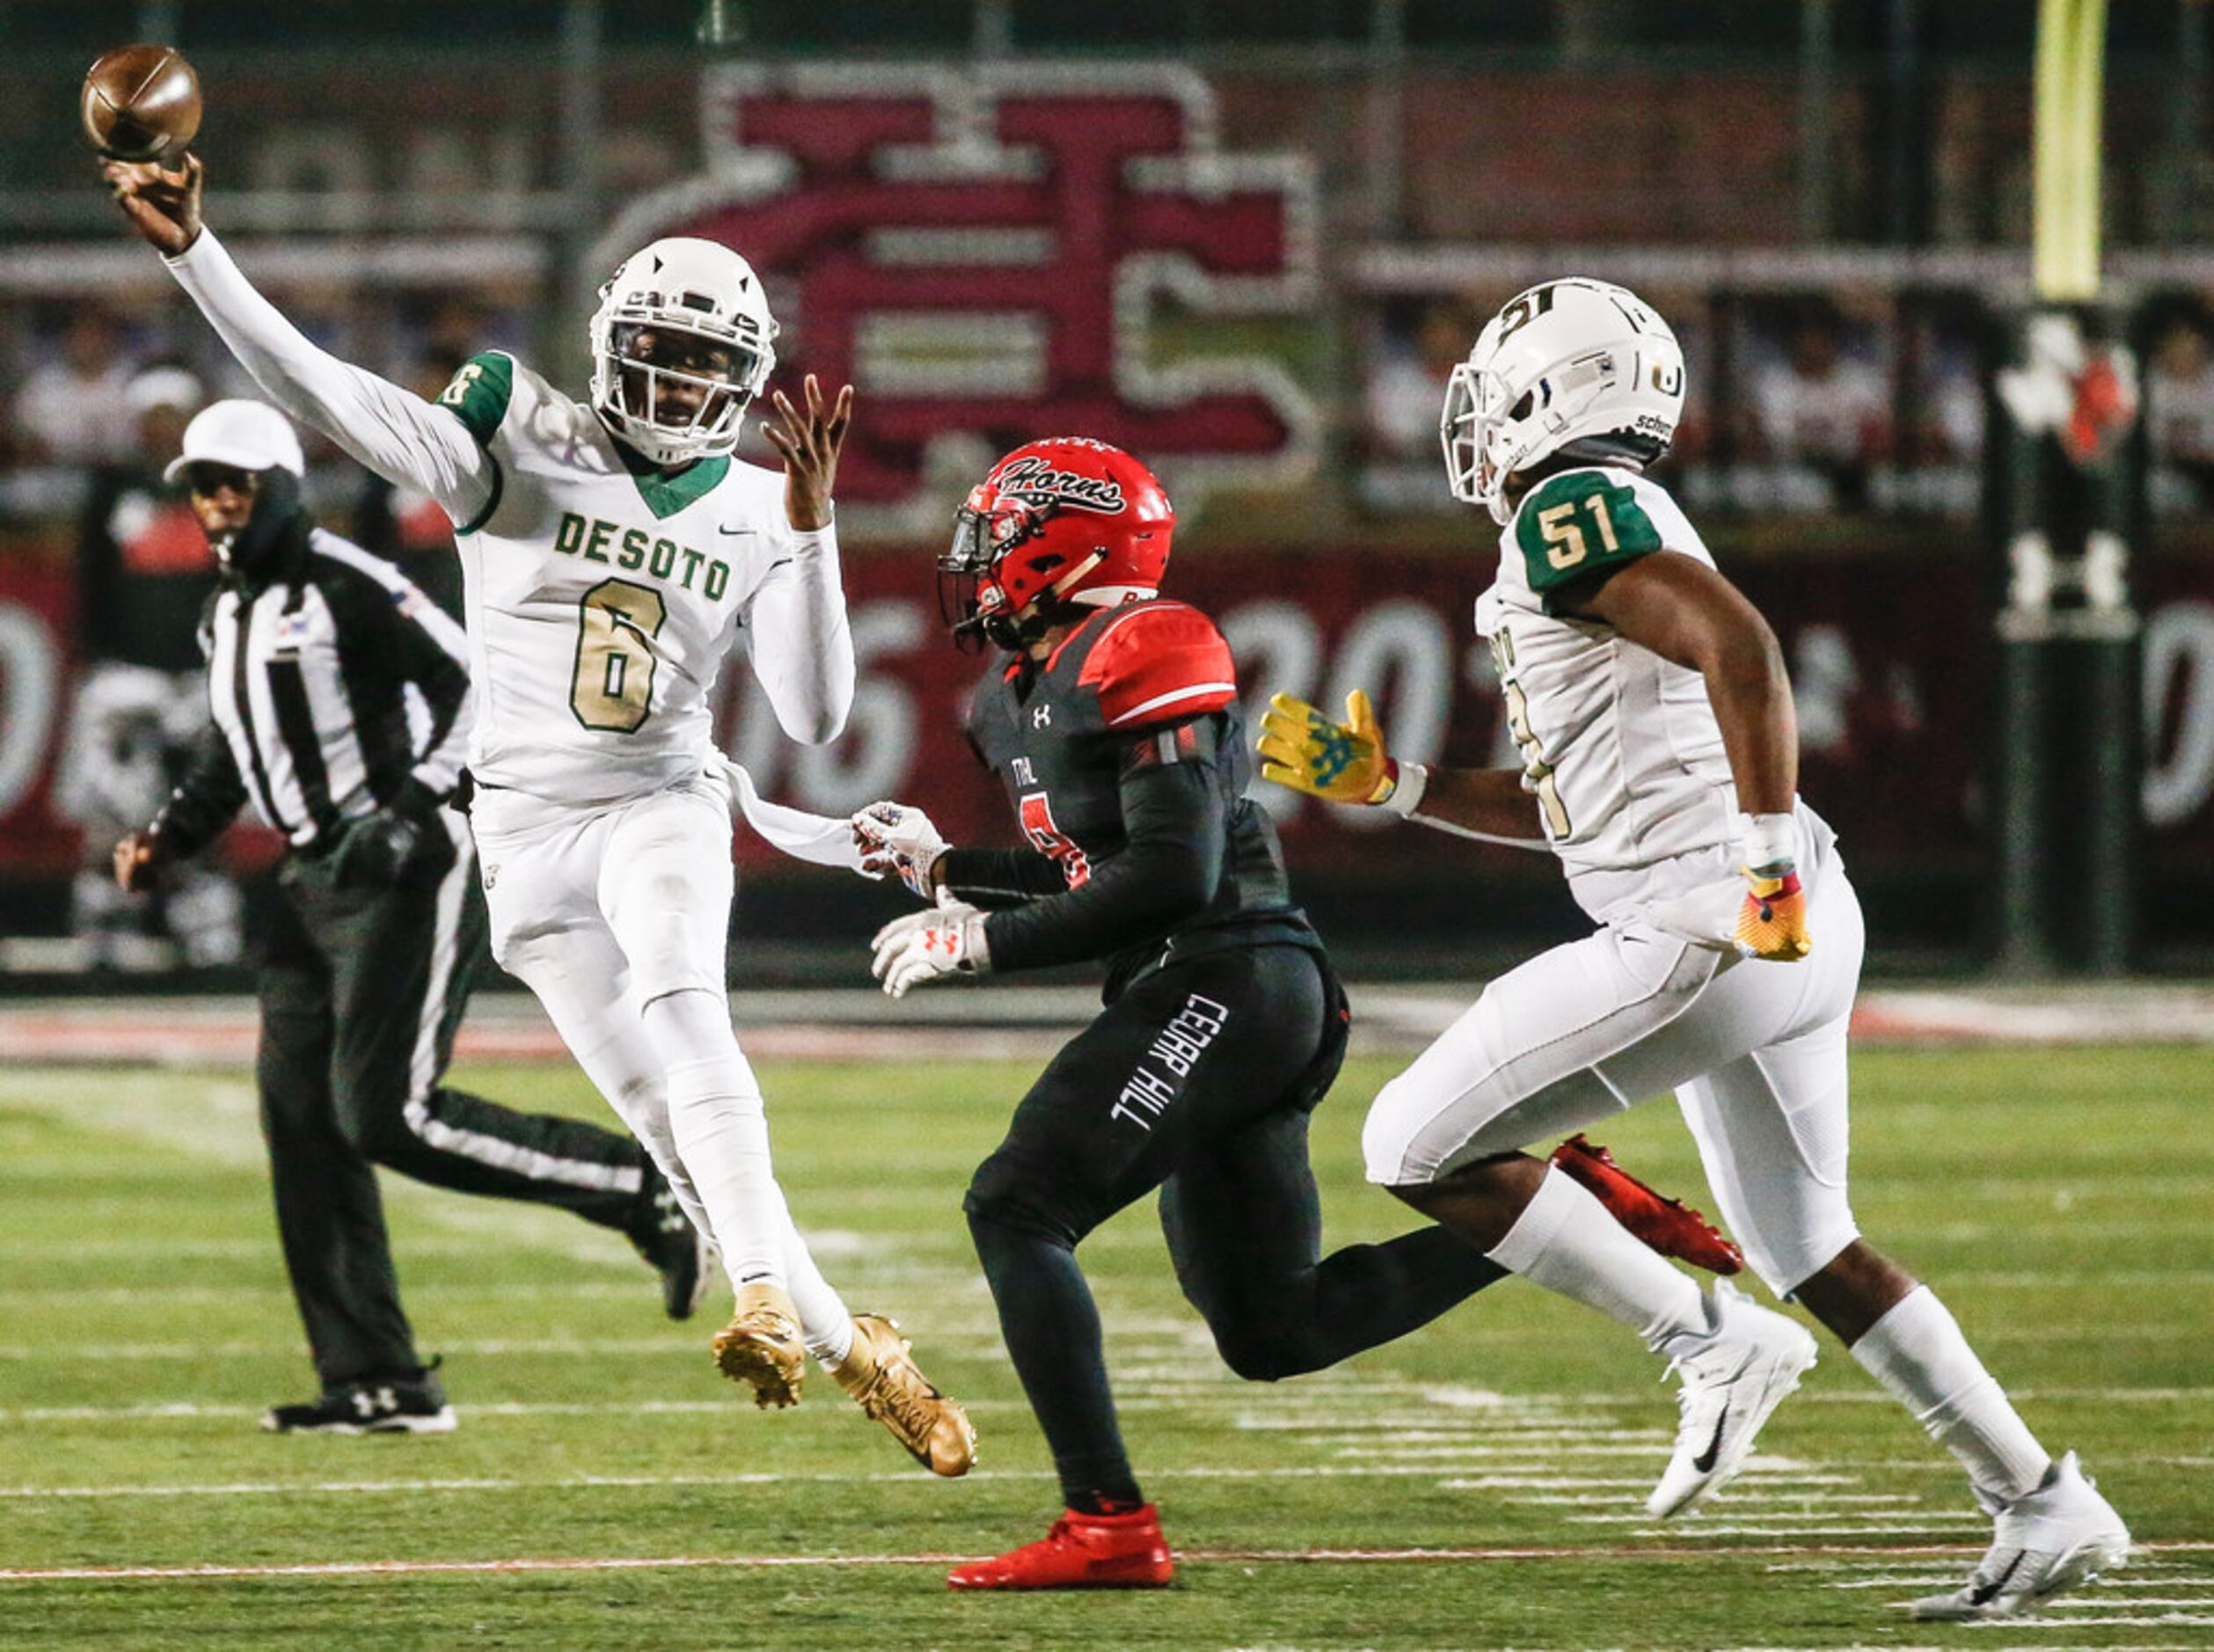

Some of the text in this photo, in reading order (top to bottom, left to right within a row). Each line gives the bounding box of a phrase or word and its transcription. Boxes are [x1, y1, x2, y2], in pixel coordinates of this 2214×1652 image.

[442, 362, 484, 405] 6
[997, 456, 1124, 505] Horns
[554, 508, 731, 603] DESOTO
[1538, 493, 1619, 570] 51
[569, 575, 667, 735] 6
[1110, 993, 1229, 1132] CEDAR HILL
